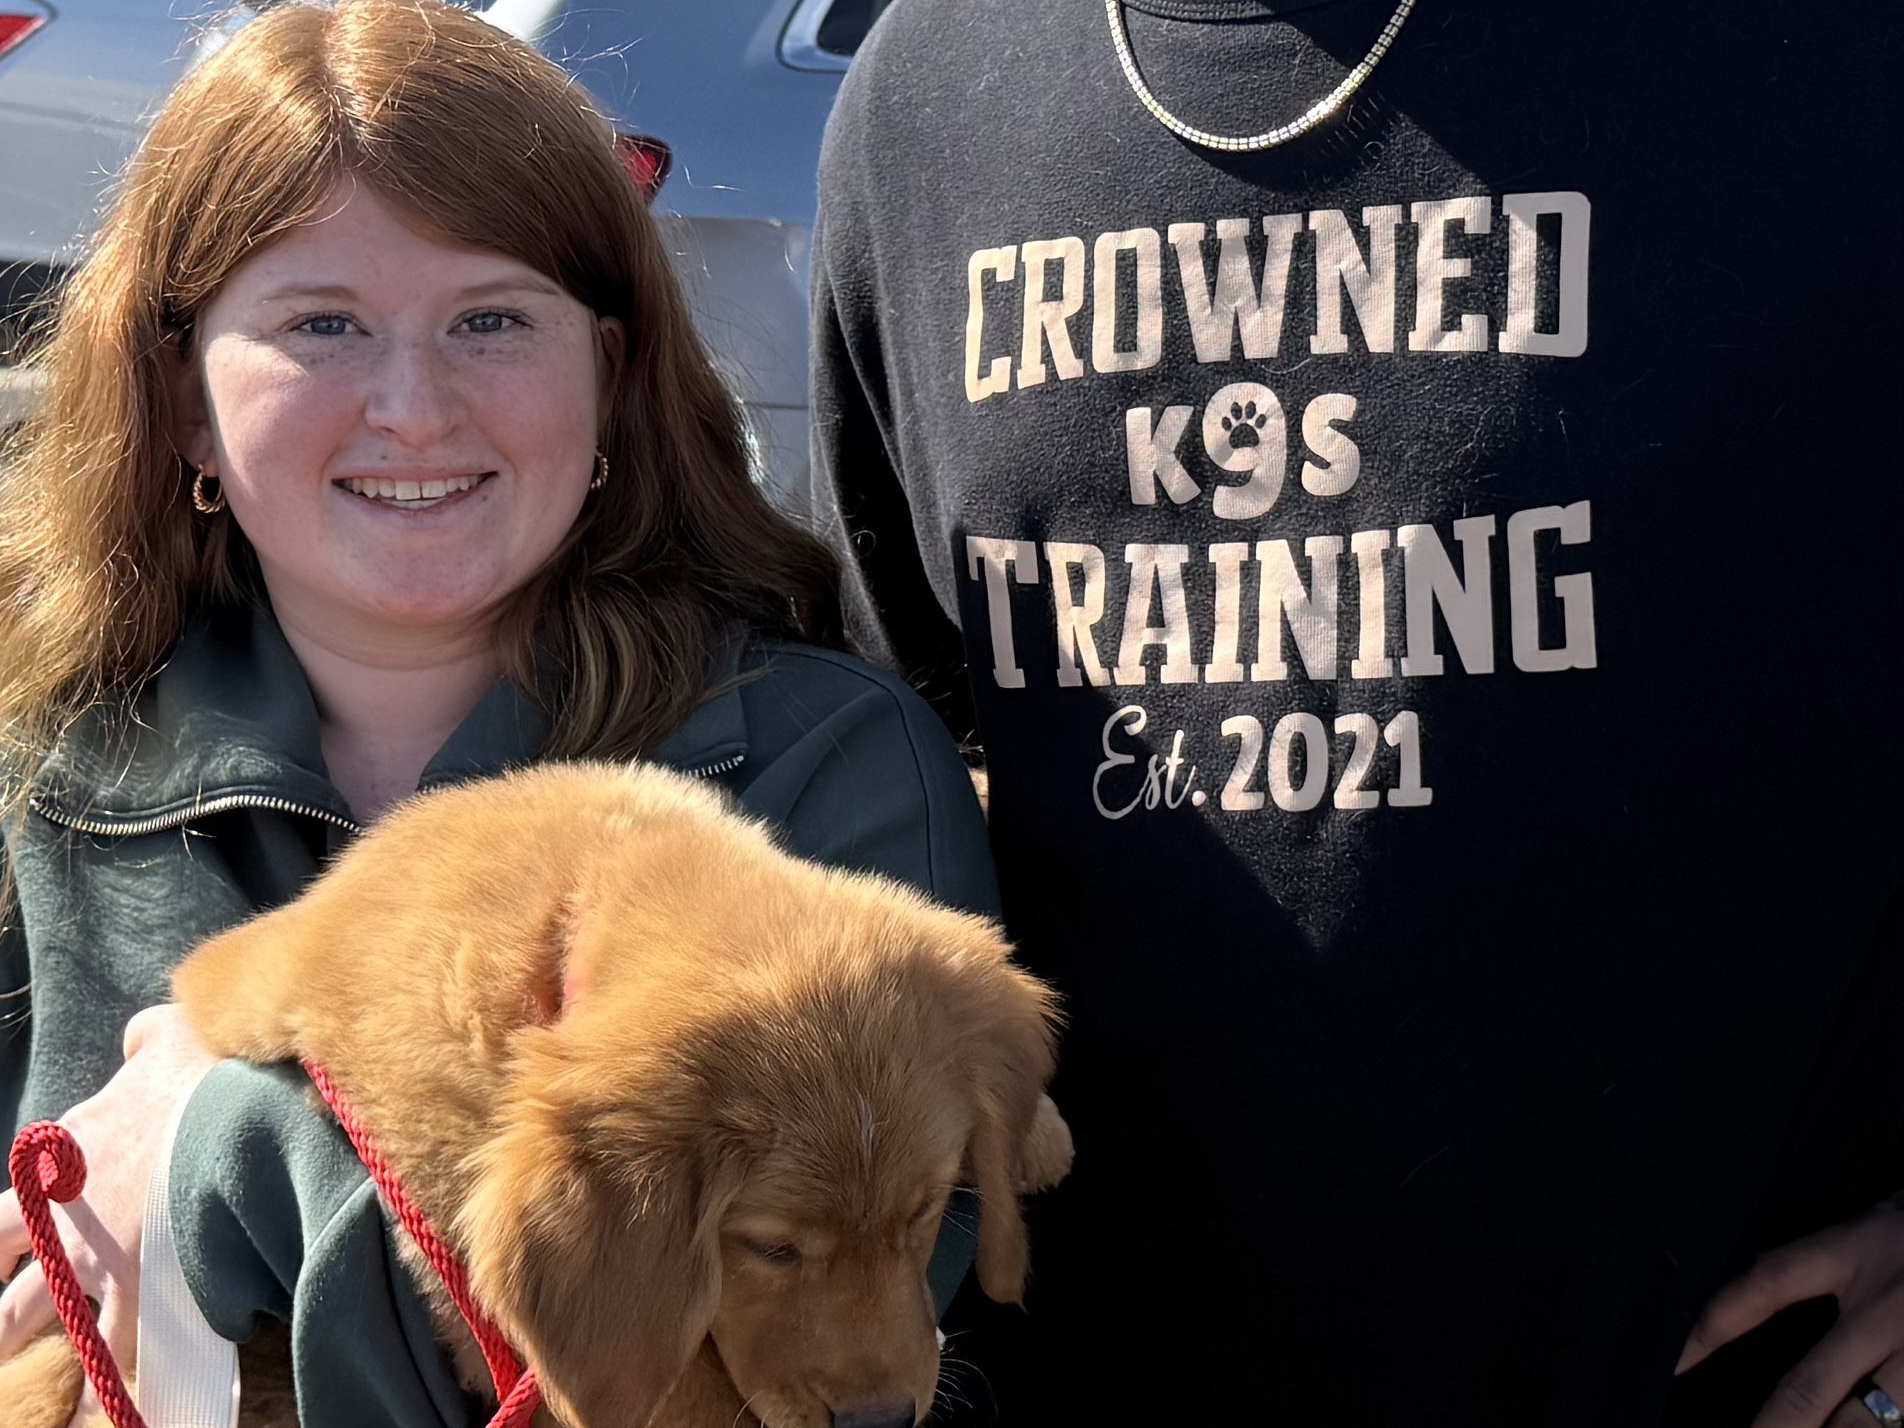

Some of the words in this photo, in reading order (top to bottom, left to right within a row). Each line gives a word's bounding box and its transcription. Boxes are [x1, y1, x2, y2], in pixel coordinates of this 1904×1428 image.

[965, 191, 1592, 403] CROWNED
[965, 500, 1598, 689] TRAINING
[1093, 704, 1206, 820] Est.
[1219, 709, 1434, 812] 2021
